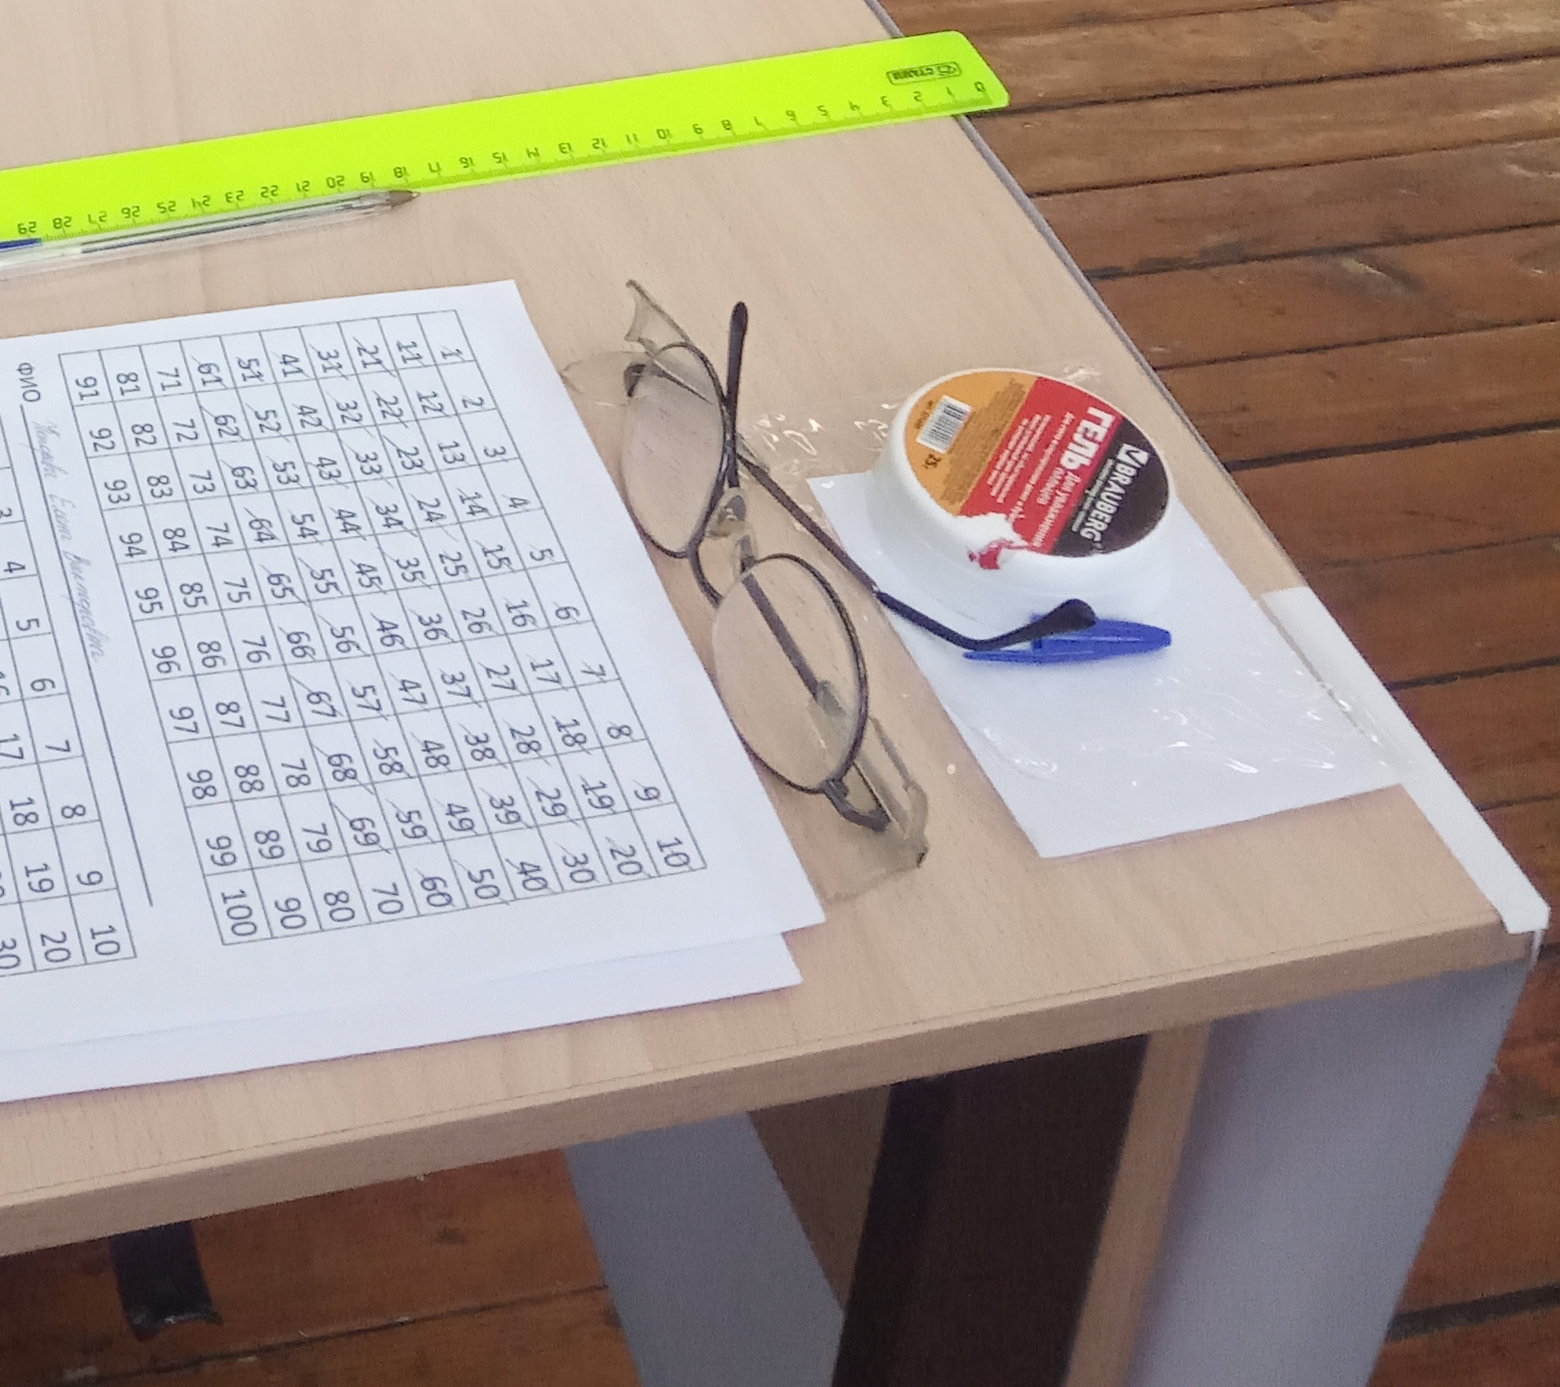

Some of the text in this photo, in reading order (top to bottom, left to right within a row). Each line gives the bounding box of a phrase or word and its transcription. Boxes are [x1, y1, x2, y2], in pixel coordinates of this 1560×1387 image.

[691, 122, 703, 135] 9
[719, 118, 732, 131] 8
[624, 131, 639, 144] 11
[655, 126, 672, 140] 10
[557, 141, 572, 154] 13
[590, 136, 606, 149] 12
[491, 150, 507, 164] 15
[524, 145, 540, 158] 14
[426, 159, 441, 173] 17
[458, 155, 473, 168] 16
[359, 169, 374, 184] 19
[392, 164, 407, 178] 18
[294, 179, 310, 192] 21
[324, 173, 345, 188] 20
[223, 189, 245, 203] 23
[258, 183, 280, 198] 22
[155, 198, 177, 214] 25
[190, 193, 212, 209] 24
[86, 209, 108, 225] 27
[119, 204, 141, 219] 26
[16, 219, 37, 235] 29
[51, 214, 73, 230] 28
[18, 362, 45, 404] ФИО
[1061, 407, 1116, 471] ГЕЛЬ
[1079, 463, 1138, 542] BRAUBERG
[3, 560, 27, 574] 4
[15, 617, 41, 632] 5
[156, 366, 356, 923] 71 72 73 74 75 76 77 78 79 80
[74, 375, 257, 937] 91 92 93 94 95 96 97 98 99 100
[29, 677, 57, 693] 6
[44, 738, 72, 754] 7
[60, 803, 87, 820] 8
[75, 870, 104, 887] 9
[89, 924, 121, 957] 10
